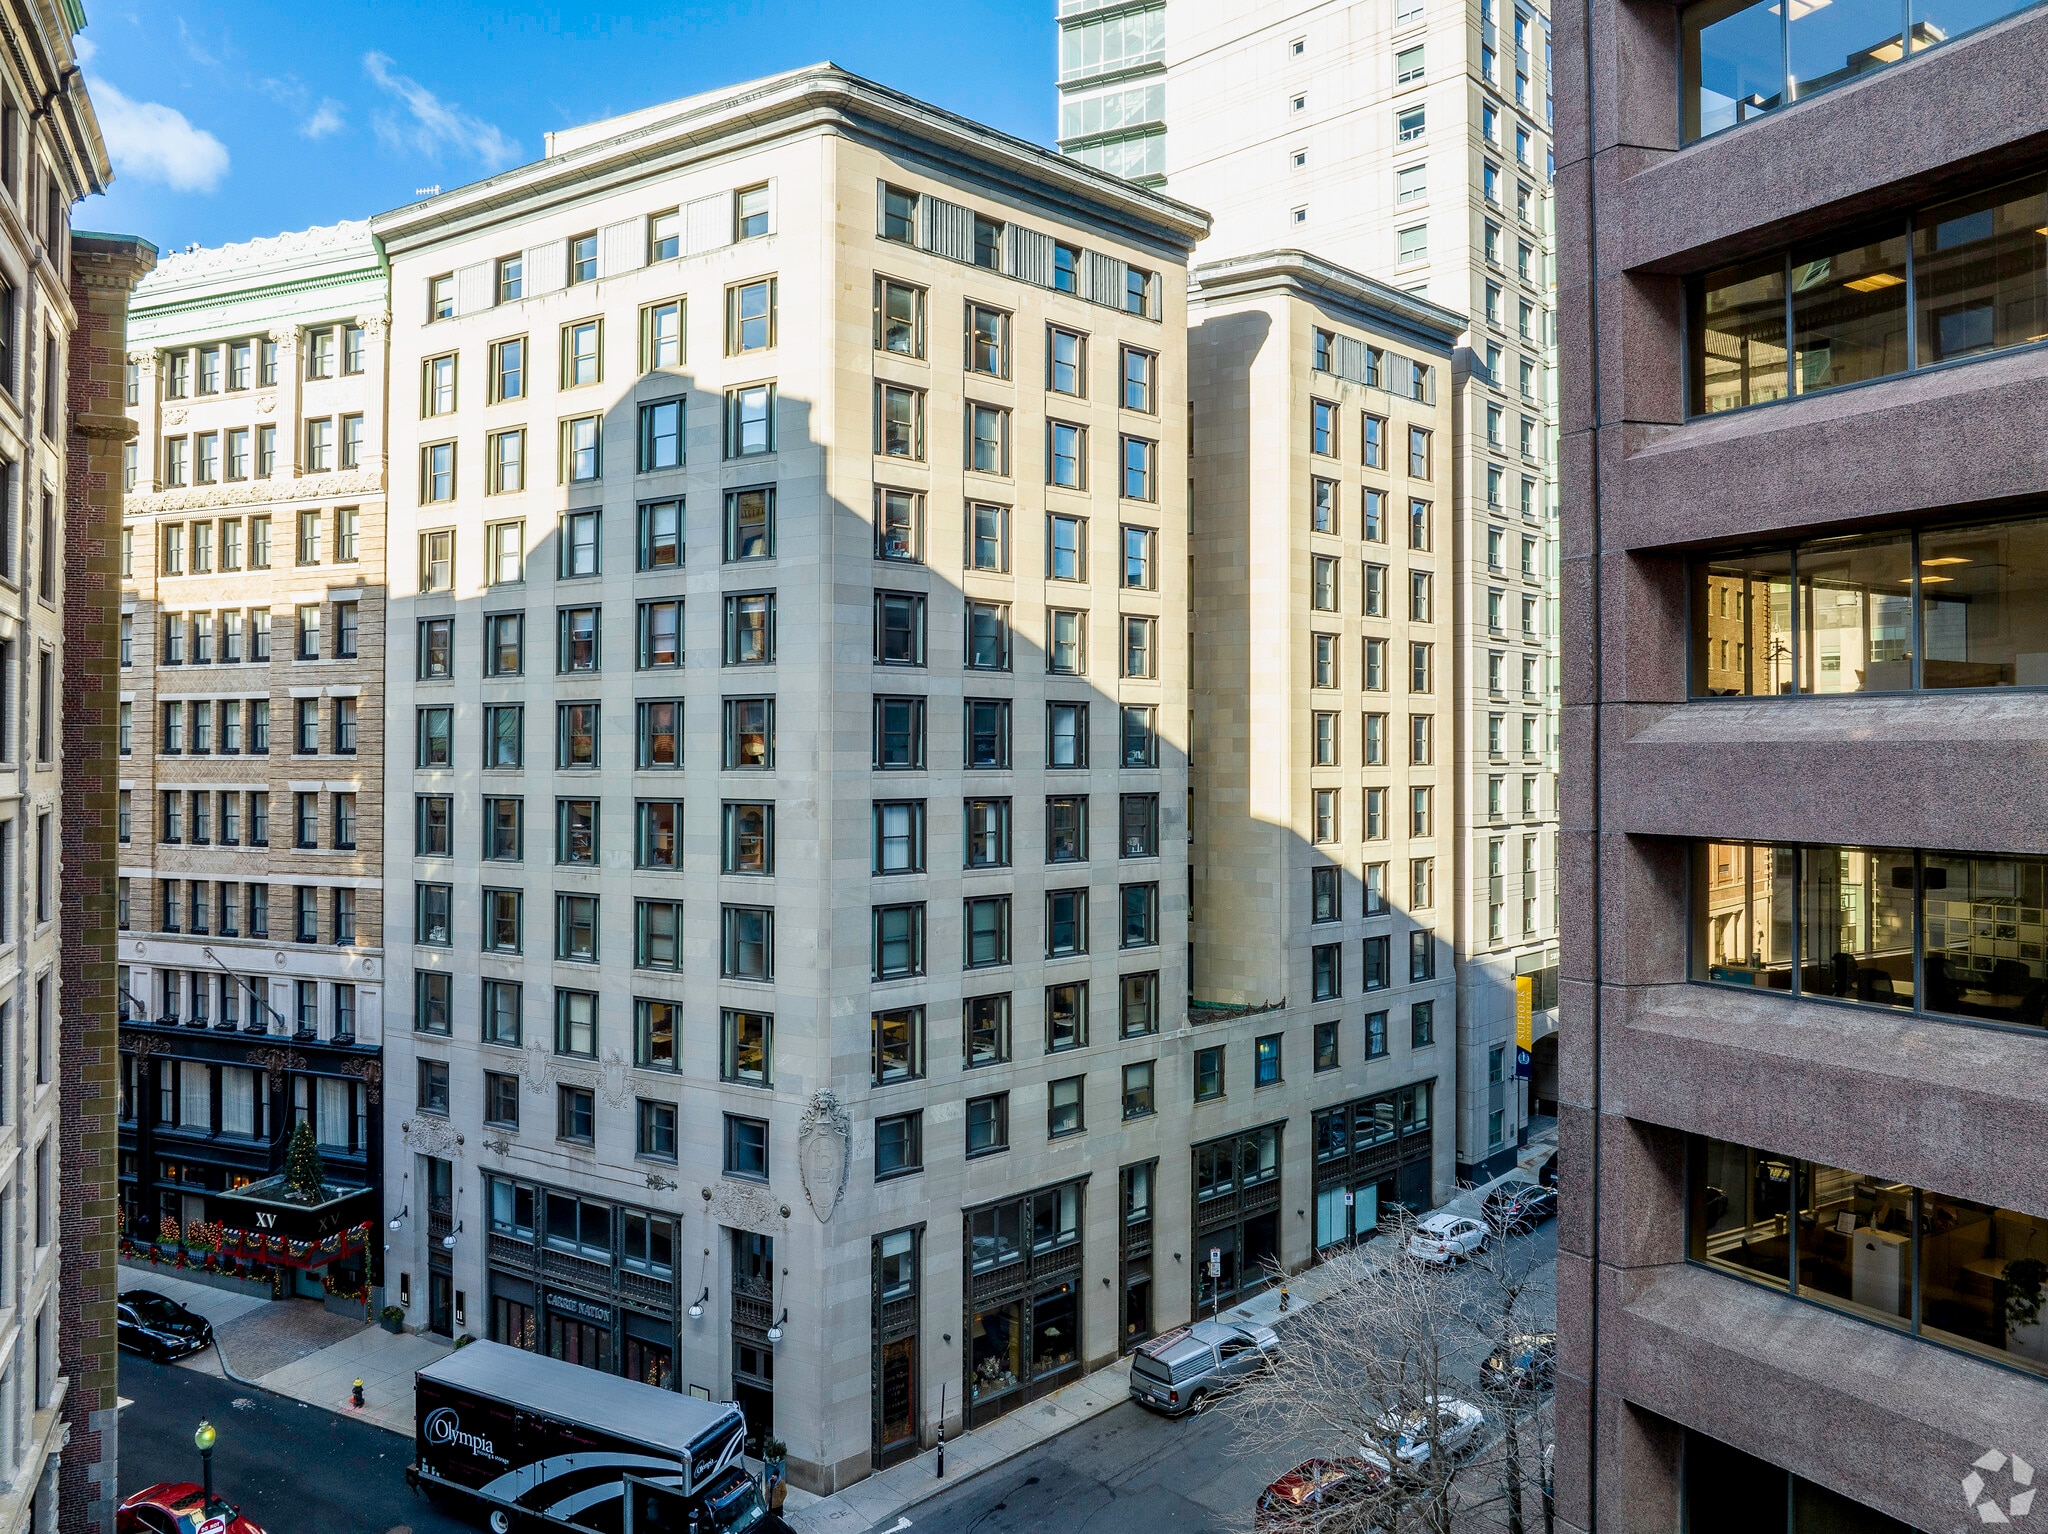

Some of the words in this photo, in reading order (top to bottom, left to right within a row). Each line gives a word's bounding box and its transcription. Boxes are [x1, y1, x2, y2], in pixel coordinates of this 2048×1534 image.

[1517, 990, 1525, 1040] SUFFOLK
[255, 1211, 278, 1229] XV
[318, 1212, 340, 1233] XV
[401, 1291, 408, 1302] 11
[456, 1309, 463, 1320] 11
[546, 1293, 578, 1312] CARRIE
[578, 1302, 611, 1322] NATION
[435, 1419, 494, 1456] Olympia
[201, 1525, 209, 1533] DO
[209, 1521, 220, 1530] NOT
